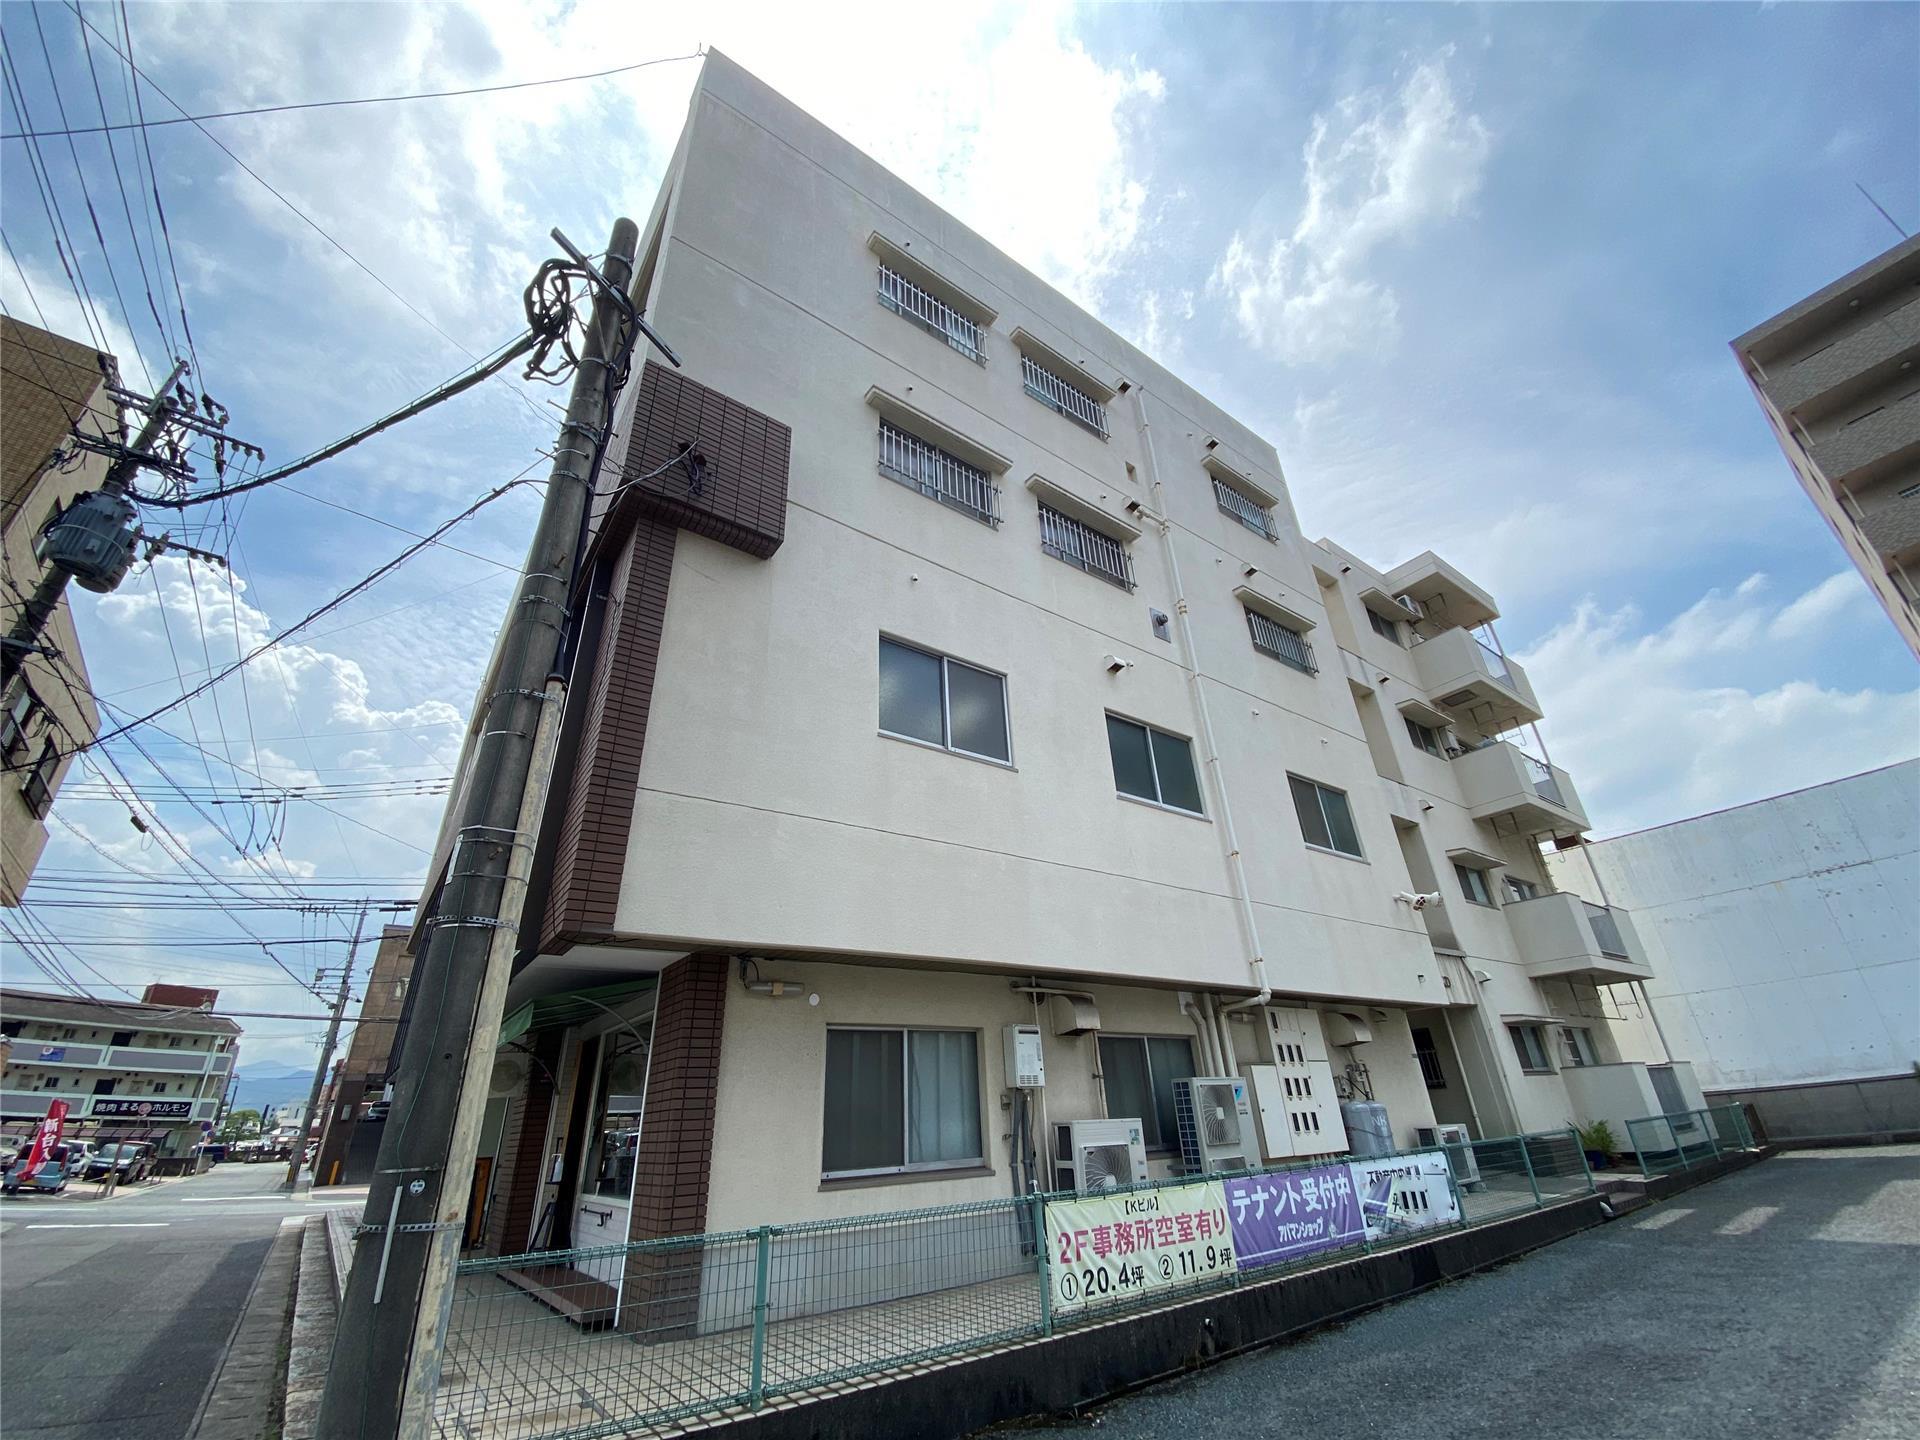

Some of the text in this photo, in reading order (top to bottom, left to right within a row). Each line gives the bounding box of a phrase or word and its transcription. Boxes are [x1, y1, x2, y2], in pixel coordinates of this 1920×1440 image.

[153, 1104, 190, 1112] ホルモン
[1232, 1173, 1352, 1225] テナント受付中
[1058, 1207, 1226, 1264] 2F事務所空室有り
